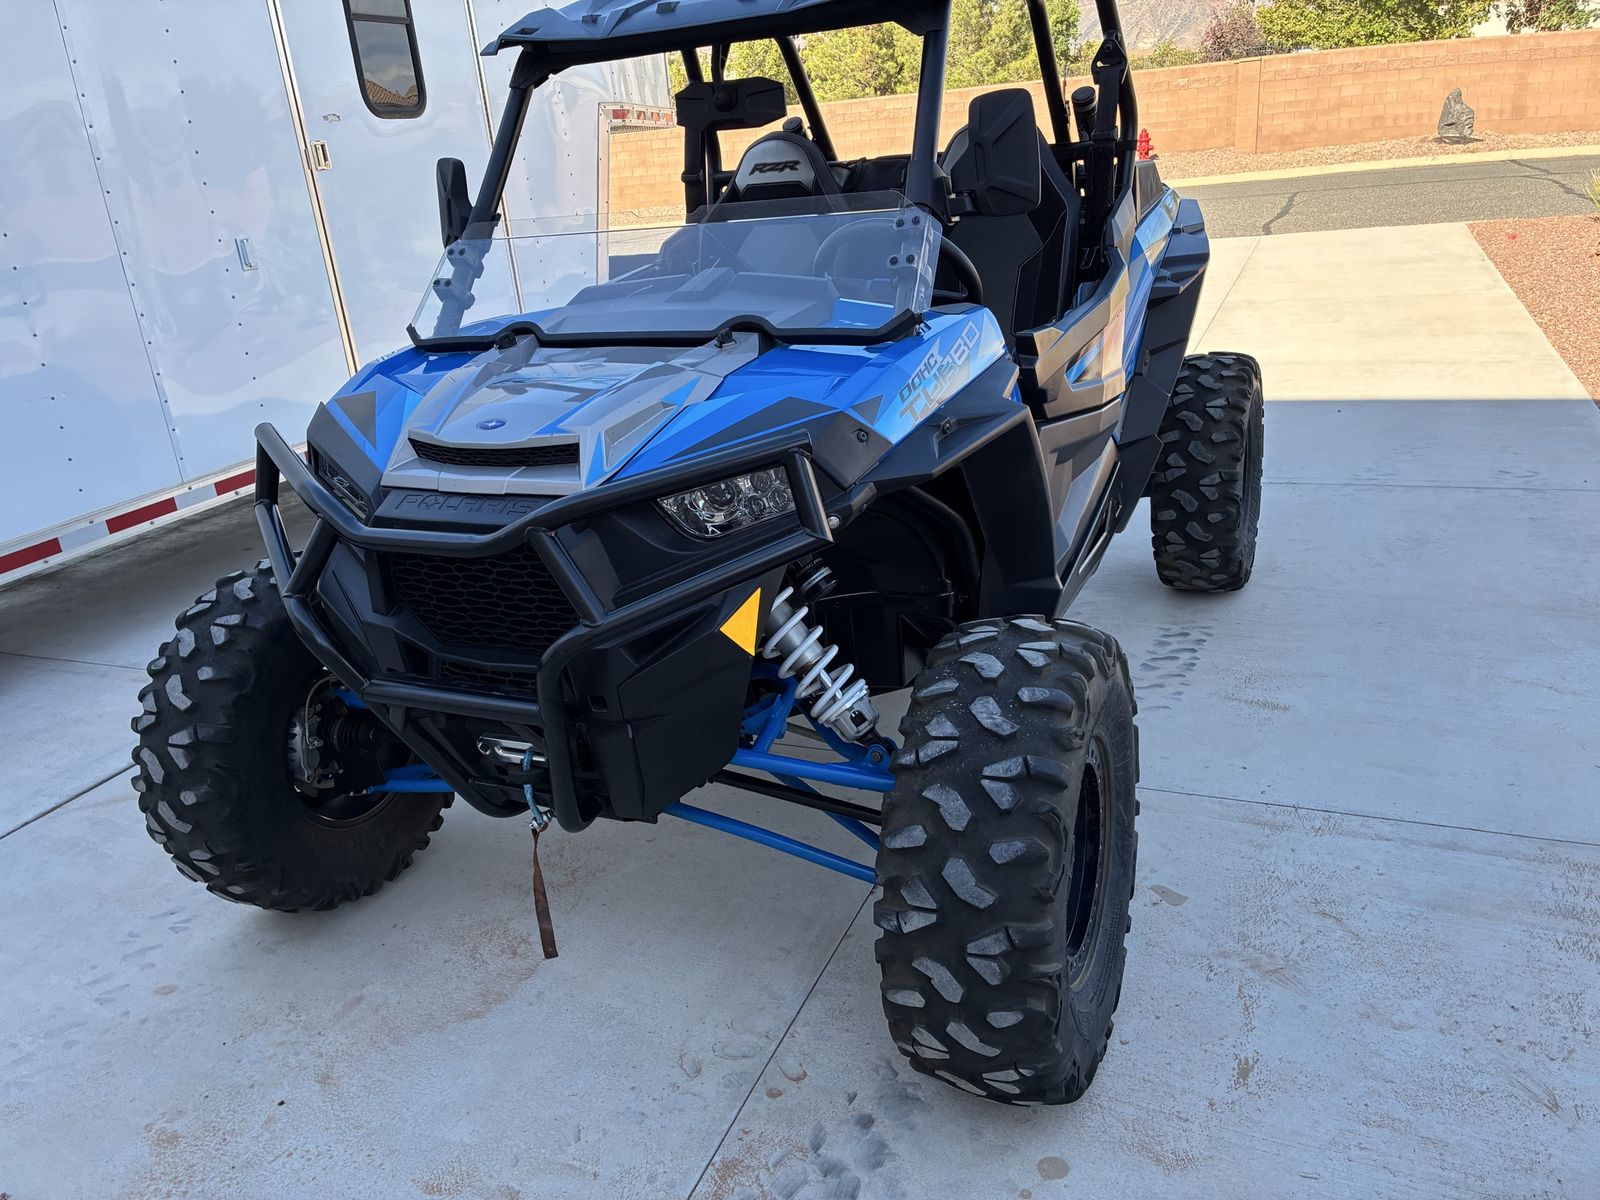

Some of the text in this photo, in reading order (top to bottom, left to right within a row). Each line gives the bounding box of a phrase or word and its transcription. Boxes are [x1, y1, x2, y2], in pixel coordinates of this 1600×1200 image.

[749, 160, 802, 176] RZR
[899, 320, 981, 423] TURBO
[899, 353, 938, 403] DOHC
[394, 493, 540, 516] POLARIS
